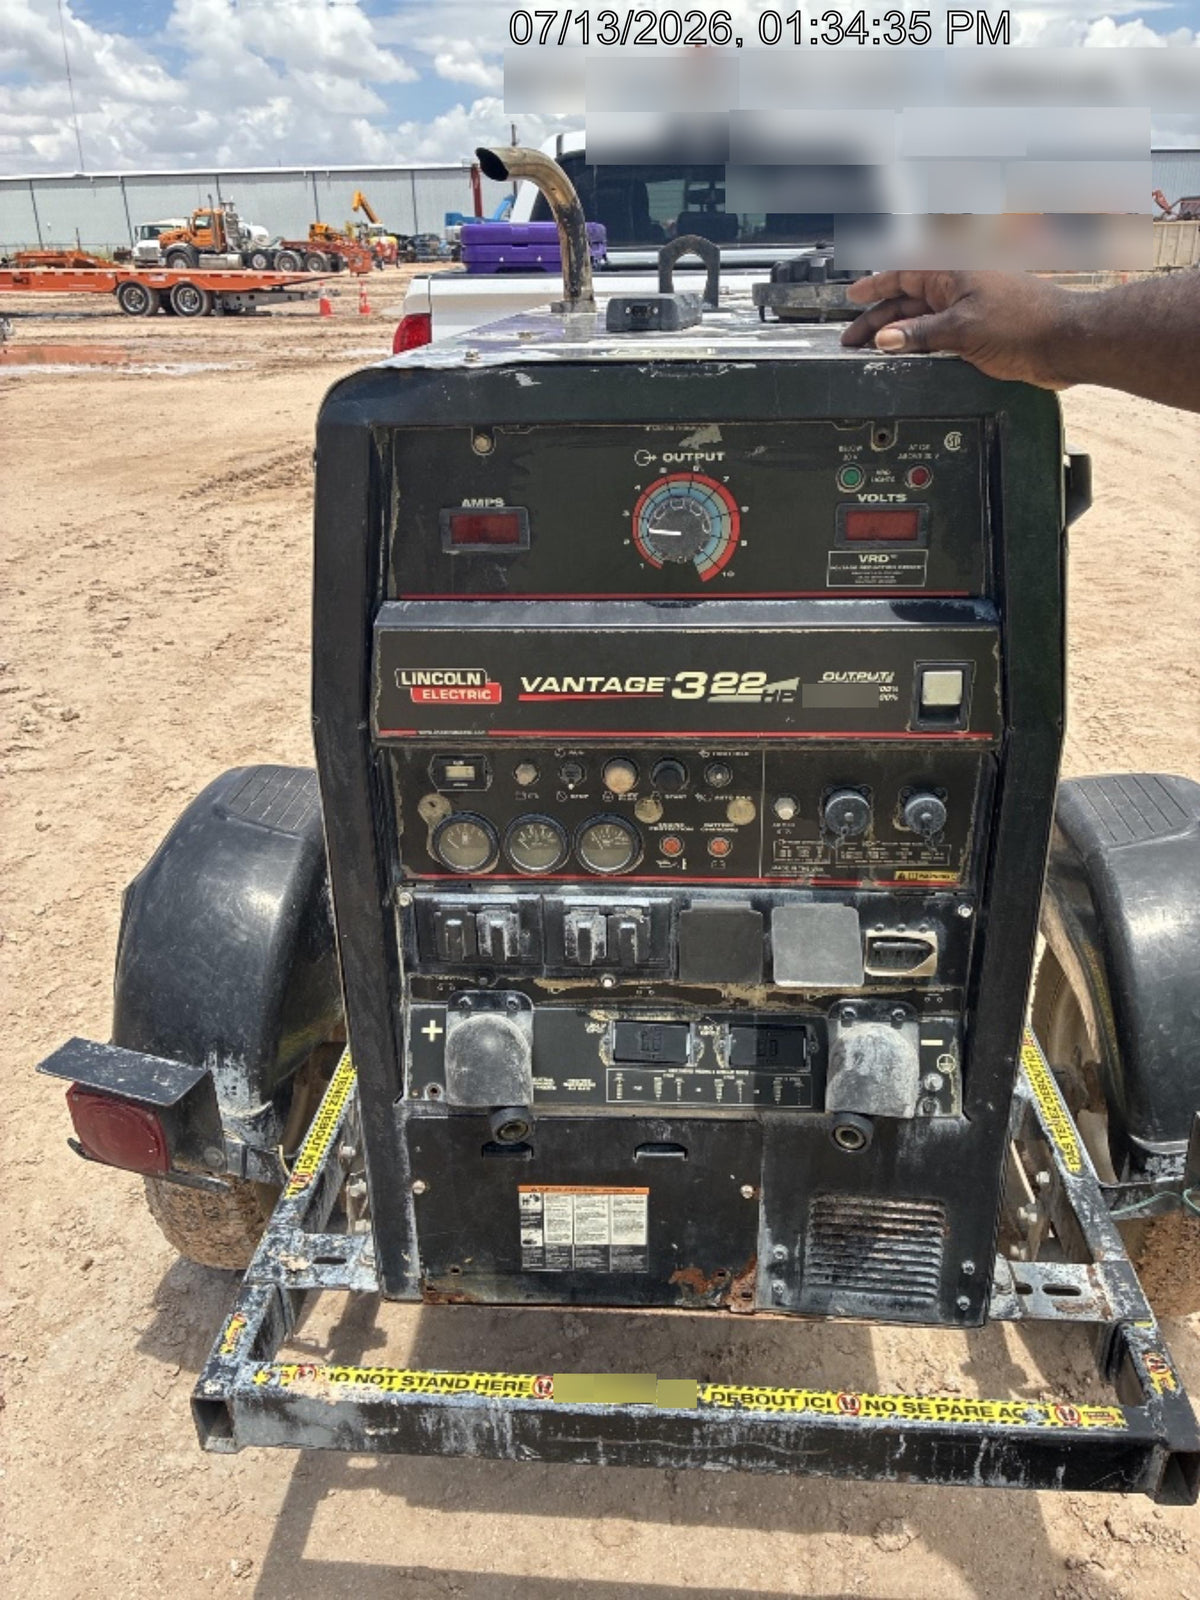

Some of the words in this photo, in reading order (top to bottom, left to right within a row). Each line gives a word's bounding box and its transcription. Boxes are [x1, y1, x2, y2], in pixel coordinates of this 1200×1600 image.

[662, 452, 725, 462] OUTPUT
[461, 497, 505, 507] AMPS
[857, 493, 907, 502] VOLTS
[858, 554, 890, 563] VRD
[401, 672, 481, 686] LINCOLN
[521, 676, 665, 693] VANTAGE
[671, 671, 768, 700] 322
[422, 688, 492, 700] ELECTRIC
[310, 1109, 336, 1152] DEBOUT
[302, 1154, 314, 1169] ICI
[354, 1373, 397, 1386] NOT
[402, 1376, 470, 1390] STAND
[474, 1378, 531, 1393] HERE
[710, 1391, 799, 1408] DEBOUT
[804, 1396, 832, 1409] ICI
[865, 1400, 896, 1412] NO
[902, 1402, 931, 1414] SE
[936, 1404, 993, 1418] PARE
